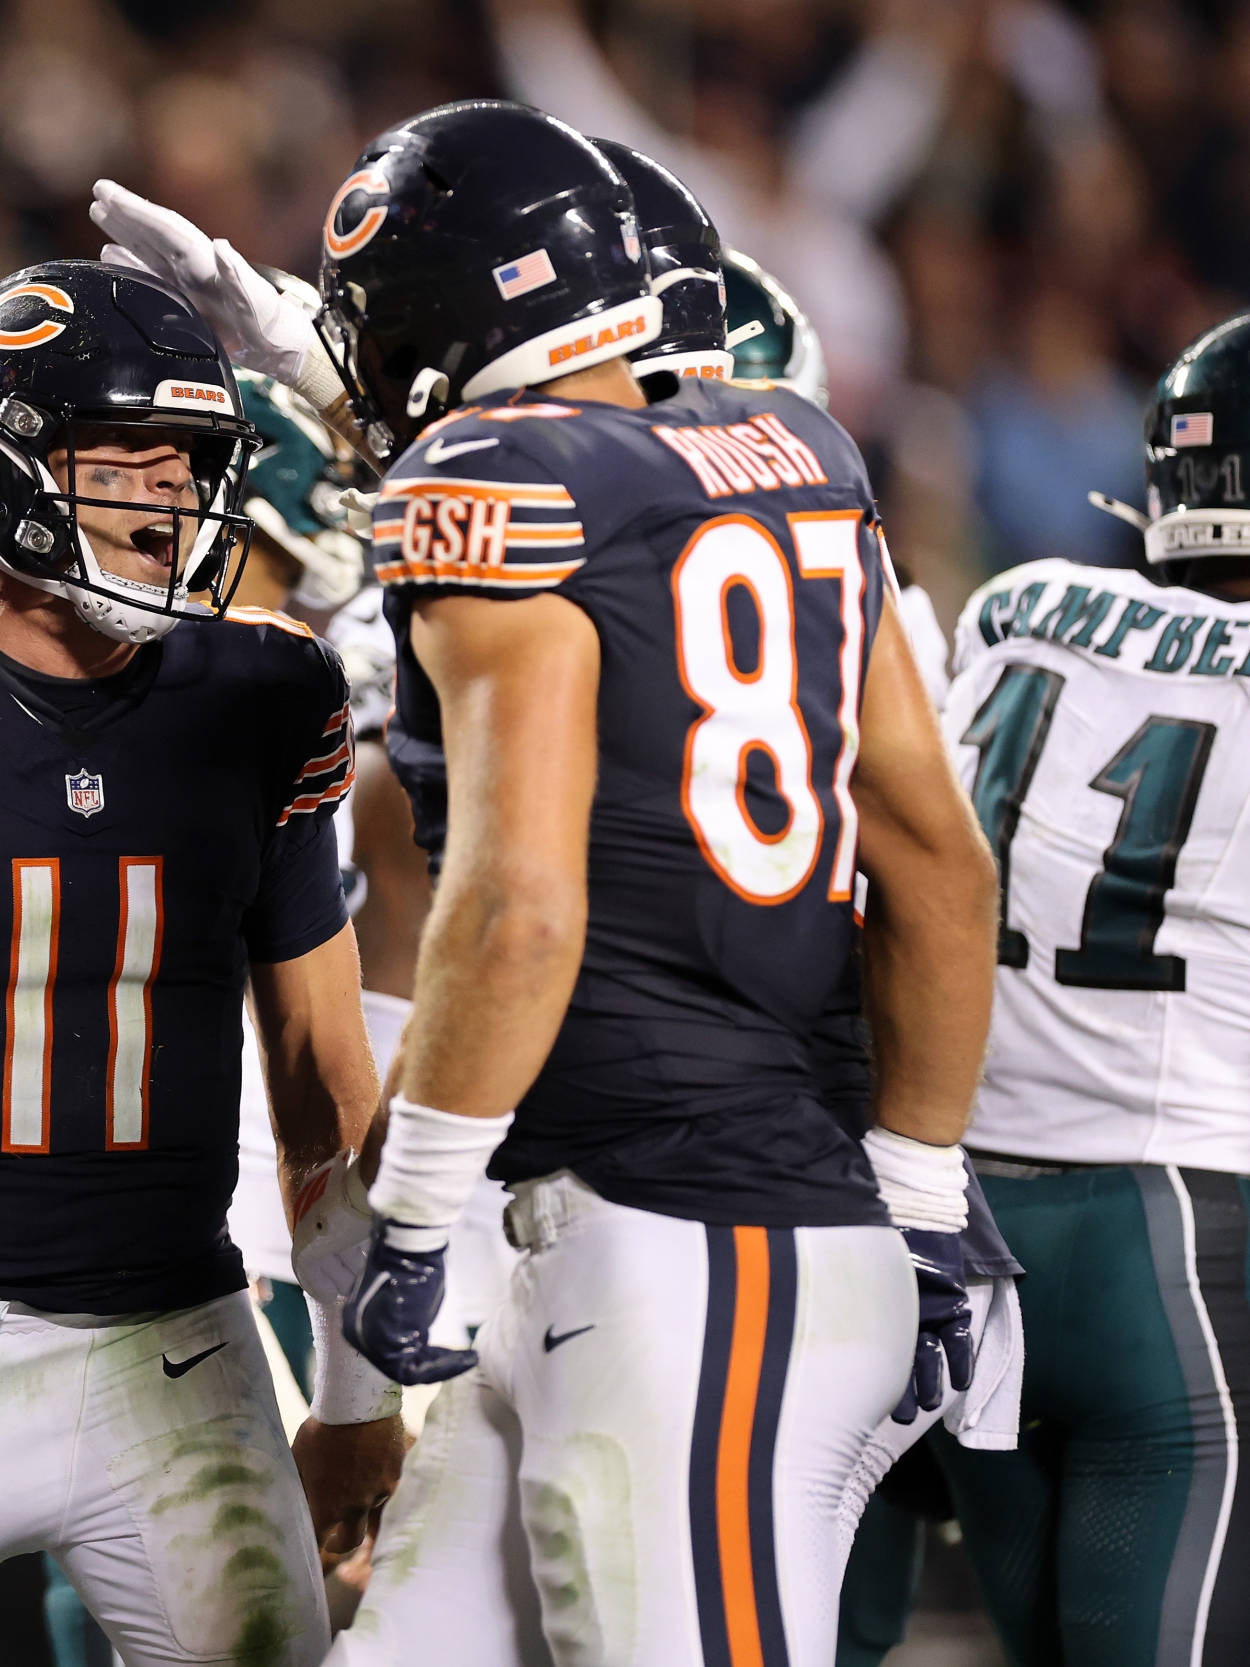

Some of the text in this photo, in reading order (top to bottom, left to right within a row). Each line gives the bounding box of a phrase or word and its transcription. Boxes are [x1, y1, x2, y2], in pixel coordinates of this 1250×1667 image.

[548, 315, 647, 367] BEARS
[170, 386, 226, 404] BEARS
[671, 365, 725, 381] ARS
[402, 496, 512, 569] GSH
[670, 509, 866, 907] 87
[73, 790, 100, 808] NFL
[959, 663, 1218, 993] 11
[1, 855, 165, 1154] 11
